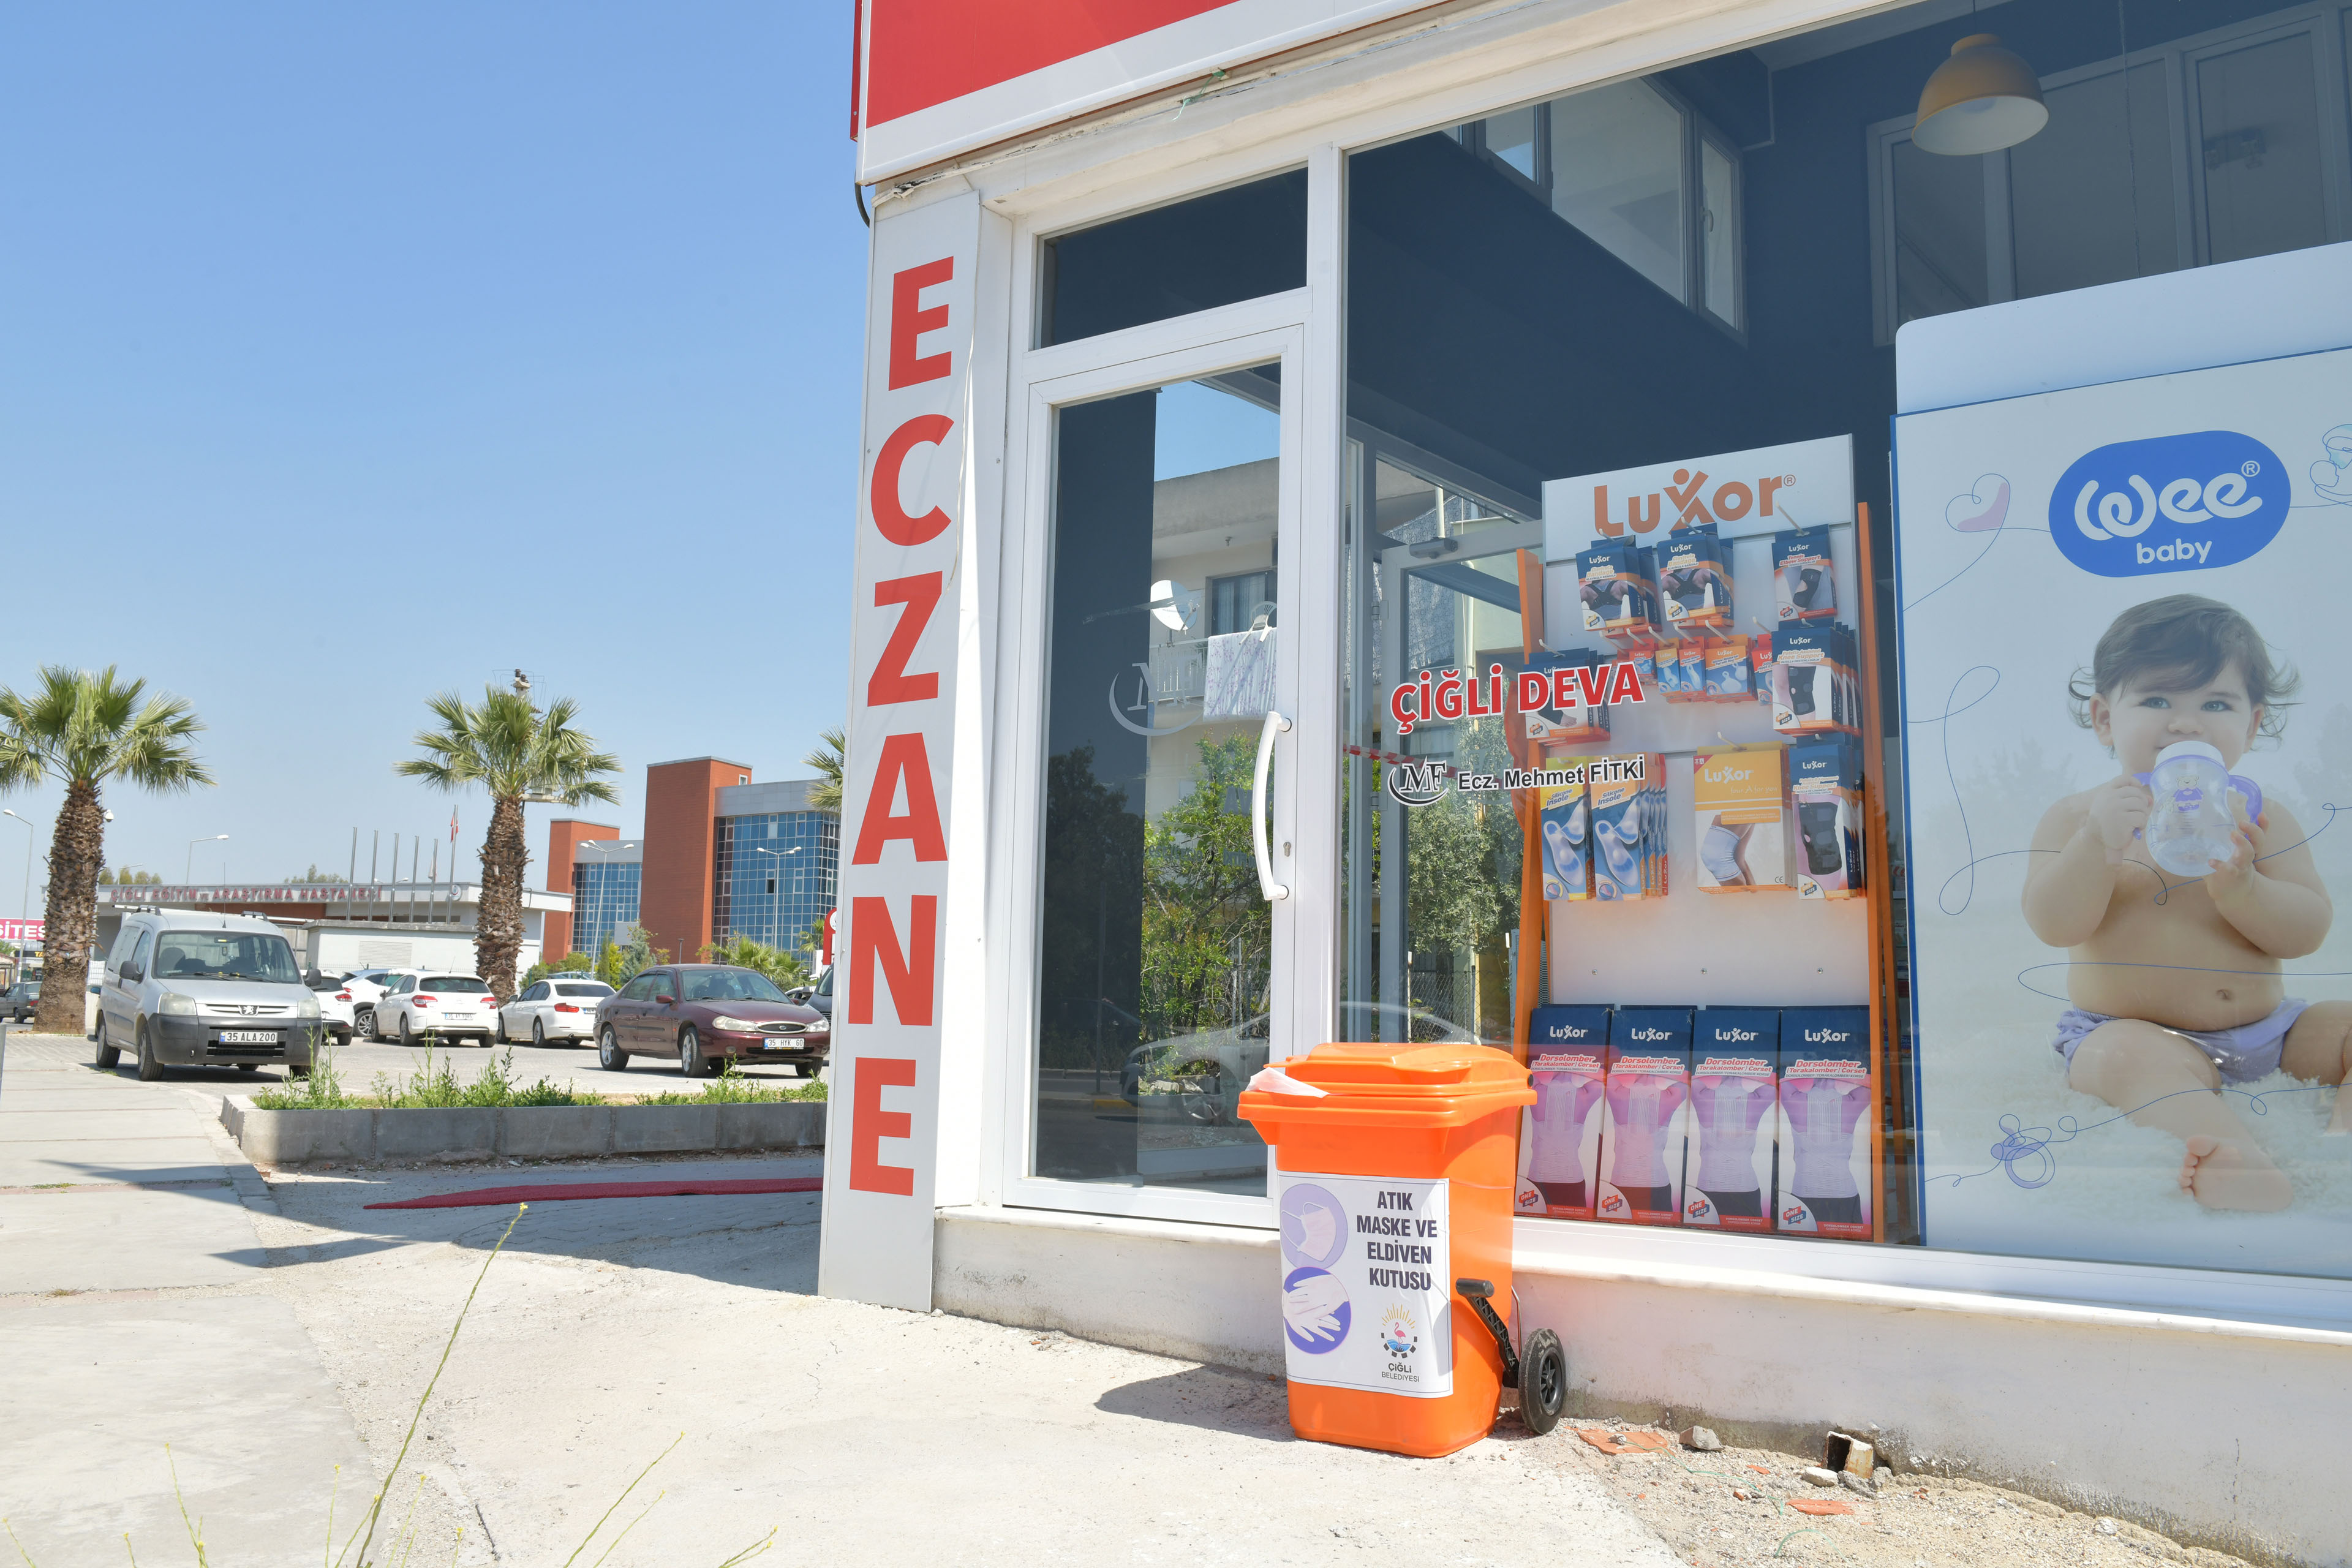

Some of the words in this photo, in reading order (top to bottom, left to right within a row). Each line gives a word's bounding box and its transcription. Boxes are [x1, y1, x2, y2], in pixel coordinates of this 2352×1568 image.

[1671, 544, 1692, 552] Luxor
[2136, 538, 2212, 564] baby
[1798, 555, 1820, 564] Support
[1391, 663, 1503, 734] ÇİĞLİ
[1518, 662, 1645, 714] DEVA
[848, 255, 954, 1196] ECZANE
[1803, 761, 1826, 769] Luxor
[1459, 772, 1498, 790] Ecz.
[1505, 766, 1583, 789] Mehmet
[1591, 756, 1644, 782] FİTKİ
[1705, 766, 1752, 784] Luxor
[1551, 788, 1572, 798] Silicone
[1602, 787, 1625, 798] Silicone
[1547, 794, 1569, 807] Insole
[1597, 793, 1621, 806] Insole
[227, 1033, 238, 1041] 35
[241, 1033, 257, 1041] ALA
[1550, 1025, 1586, 1039] Luxor
[1632, 1028, 1670, 1042] Luxor
[1716, 1028, 1756, 1042] Luxor
[1804, 1028, 1848, 1044] Luxor
[1540, 1054, 1595, 1063] Dorsolomber
[1706, 1058, 1766, 1066] Dorsolomber
[1377, 1191, 1413, 1211] ATIK
[1608, 1202, 1620, 1210] SIZE
[1691, 1202, 1702, 1210] ONE
[1695, 1208, 1707, 1216] SIZE
[1786, 1208, 1798, 1217] ONE
[1790, 1214, 1803, 1223] SIZE
[1357, 1215, 1411, 1237] MASKE
[1415, 1219, 1437, 1238] VE
[1367, 1239, 1432, 1264] ELDİVEN
[1369, 1268, 1431, 1291] KUTUSU
